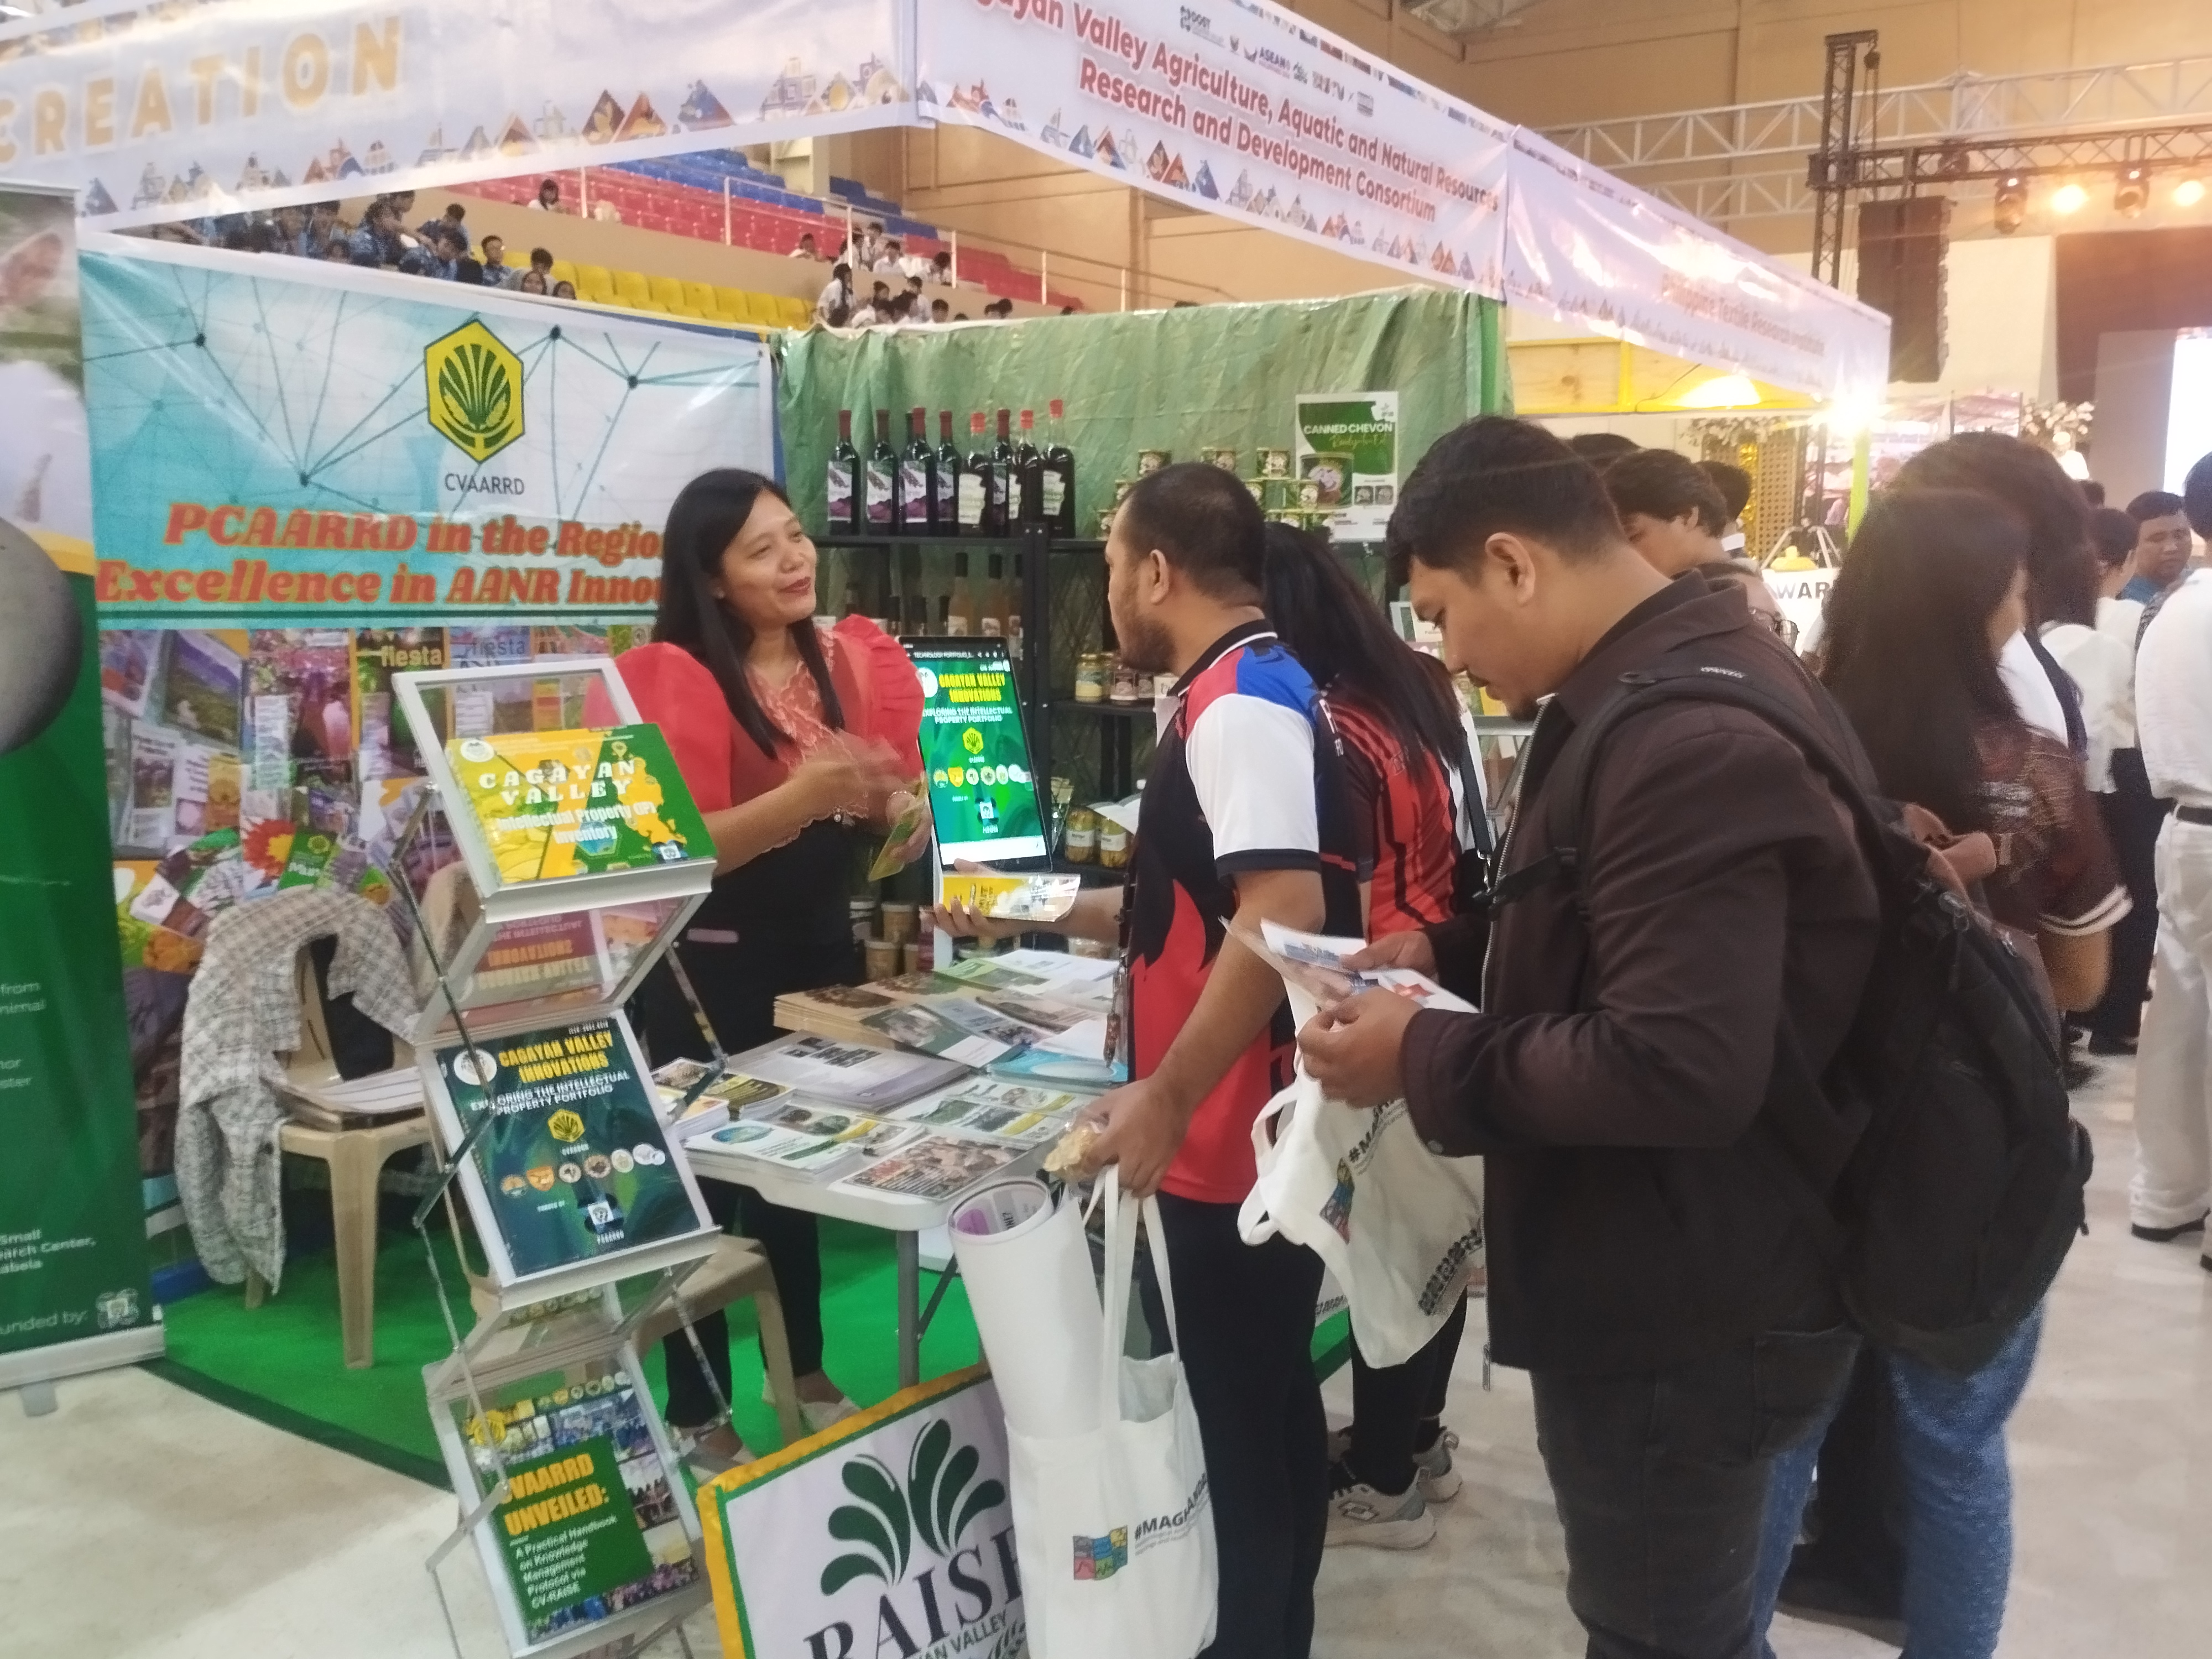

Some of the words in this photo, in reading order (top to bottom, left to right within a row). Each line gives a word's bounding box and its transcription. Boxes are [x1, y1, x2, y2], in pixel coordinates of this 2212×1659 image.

[1074, 2, 1147, 70] Valley
[1152, 42, 1273, 124] Agriculture,
[1278, 98, 1344, 148] Aquatic
[1348, 131, 1378, 161] and
[1382, 142, 1433, 186] Natural
[1437, 166, 1499, 211] Resources
[1079, 58, 1187, 128] Research
[1192, 111, 1232, 145] and
[1237, 123, 1352, 191] Development
[1357, 170, 1436, 222] Consortium
[1303, 424, 1348, 435] CANNED
[1348, 423, 1392, 434] CHEVON
[445, 473, 525, 495] CVAARRD
[426, 517, 472, 552] in
[482, 515, 549, 555] the
[556, 520, 664, 567] Regio
[95, 560, 382, 603] Excellence
[389, 563, 436, 603] in
[446, 567, 560, 604] AANR
[977, 672, 1005, 686] VALLEY
[969, 715, 1003, 723] PORTFOLIO
[479, 759, 635, 789] CAGAYAN
[500, 778, 633, 805] VALLEY
[576, 804, 632, 823] Property
[554, 826, 618, 844] Inventory
[499, 1040, 563, 1068] CAGAYAN
[564, 1030, 613, 1055] VALLEY
[519, 1051, 609, 1083] INNOVATIONS
[557, 1070, 629, 1093] INTELLECTUAL
[497, 1096, 551, 1115] PROPERTY
[554, 1083, 613, 1104] PORTFOLIO
[501, 1453, 594, 1504] VAARRD
[504, 1484, 609, 1536] UNVEILED:
[950, 1609, 1007, 1655] VALLEY
